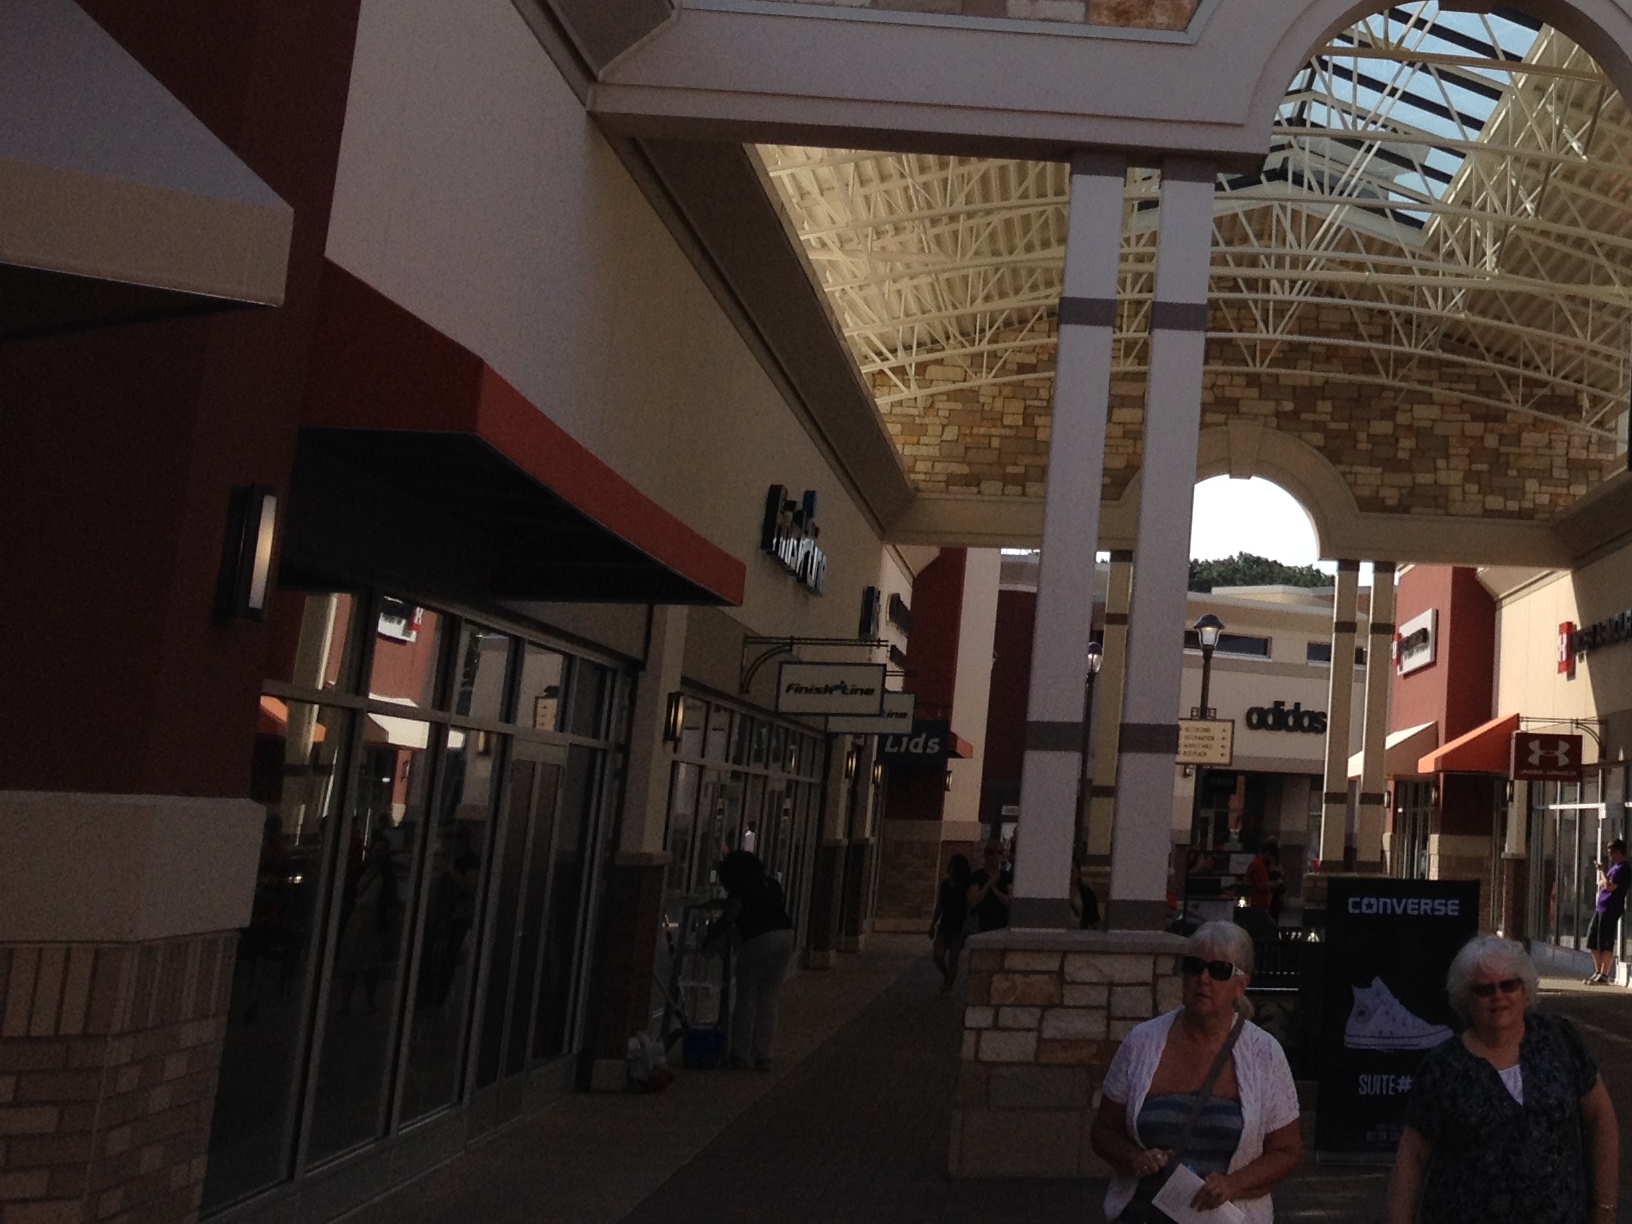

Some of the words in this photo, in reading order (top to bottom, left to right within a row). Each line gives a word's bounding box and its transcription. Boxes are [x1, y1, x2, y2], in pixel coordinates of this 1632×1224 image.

[886, 709, 908, 719] ine
[1246, 700, 1328, 734] adidas
[1346, 896, 1460, 917] CONVERSE
